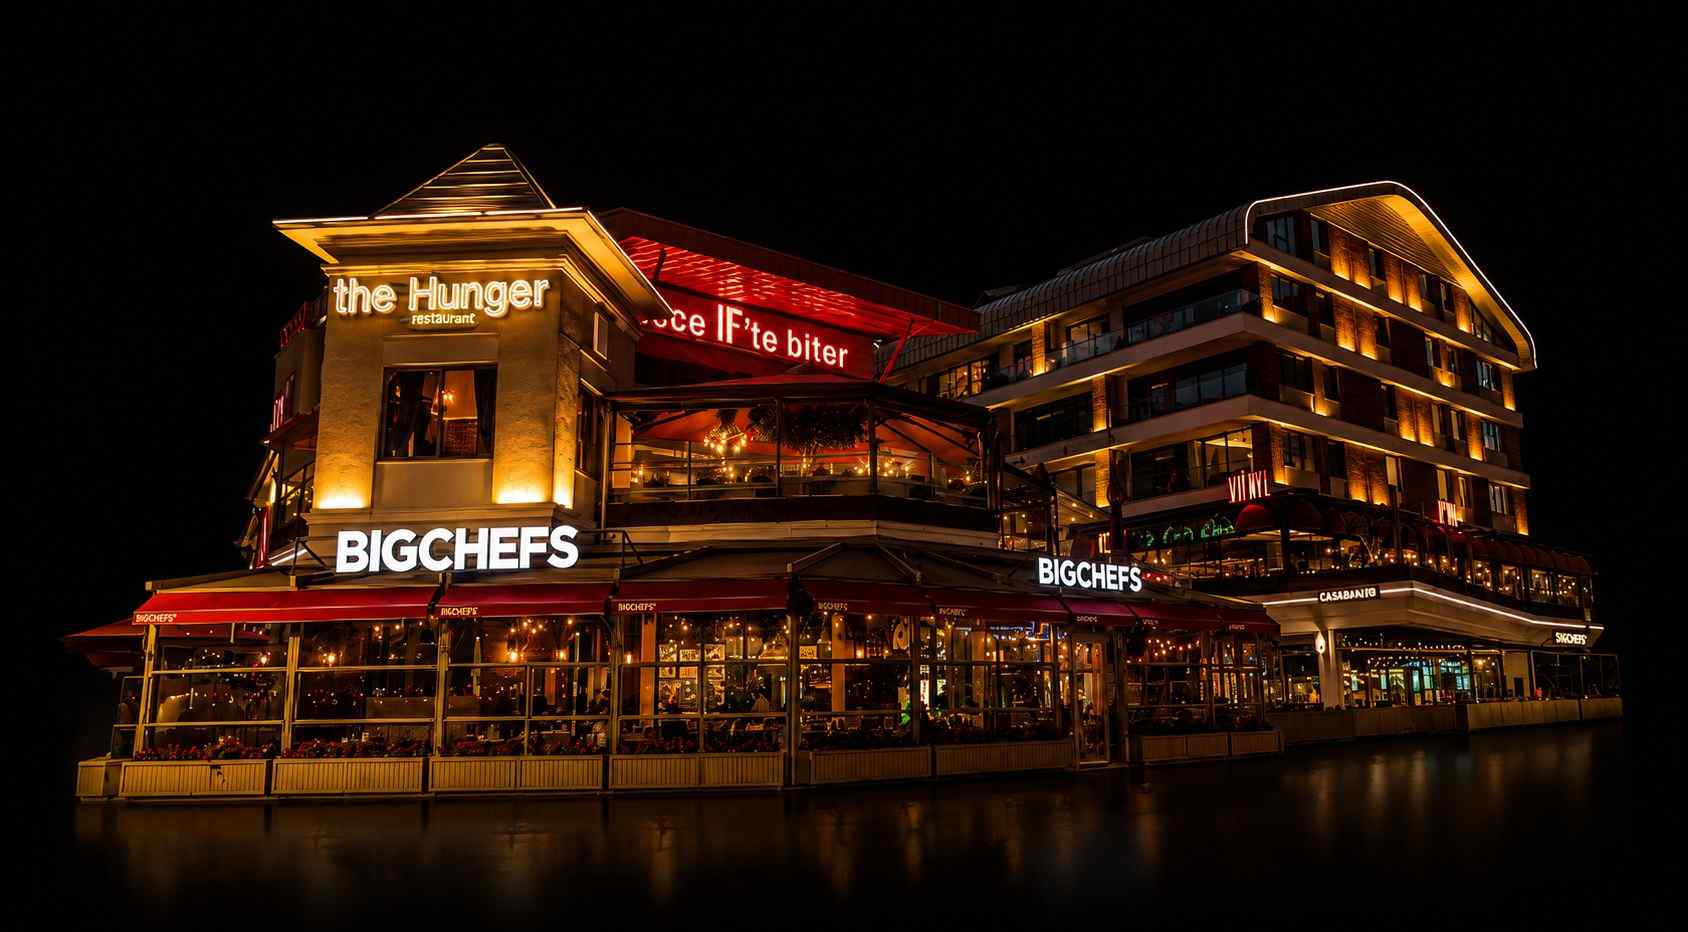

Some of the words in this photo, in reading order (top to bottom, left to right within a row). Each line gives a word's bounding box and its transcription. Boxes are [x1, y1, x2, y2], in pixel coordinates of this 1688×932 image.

[333, 278, 397, 314] the
[408, 276, 549, 318] Hunger
[411, 312, 475, 325] restaurant
[641, 309, 706, 336] ce
[787, 329, 849, 368] biter
[336, 525, 579, 573] BIGCHEFS
[1038, 556, 1143, 593] BIGCHEFS
